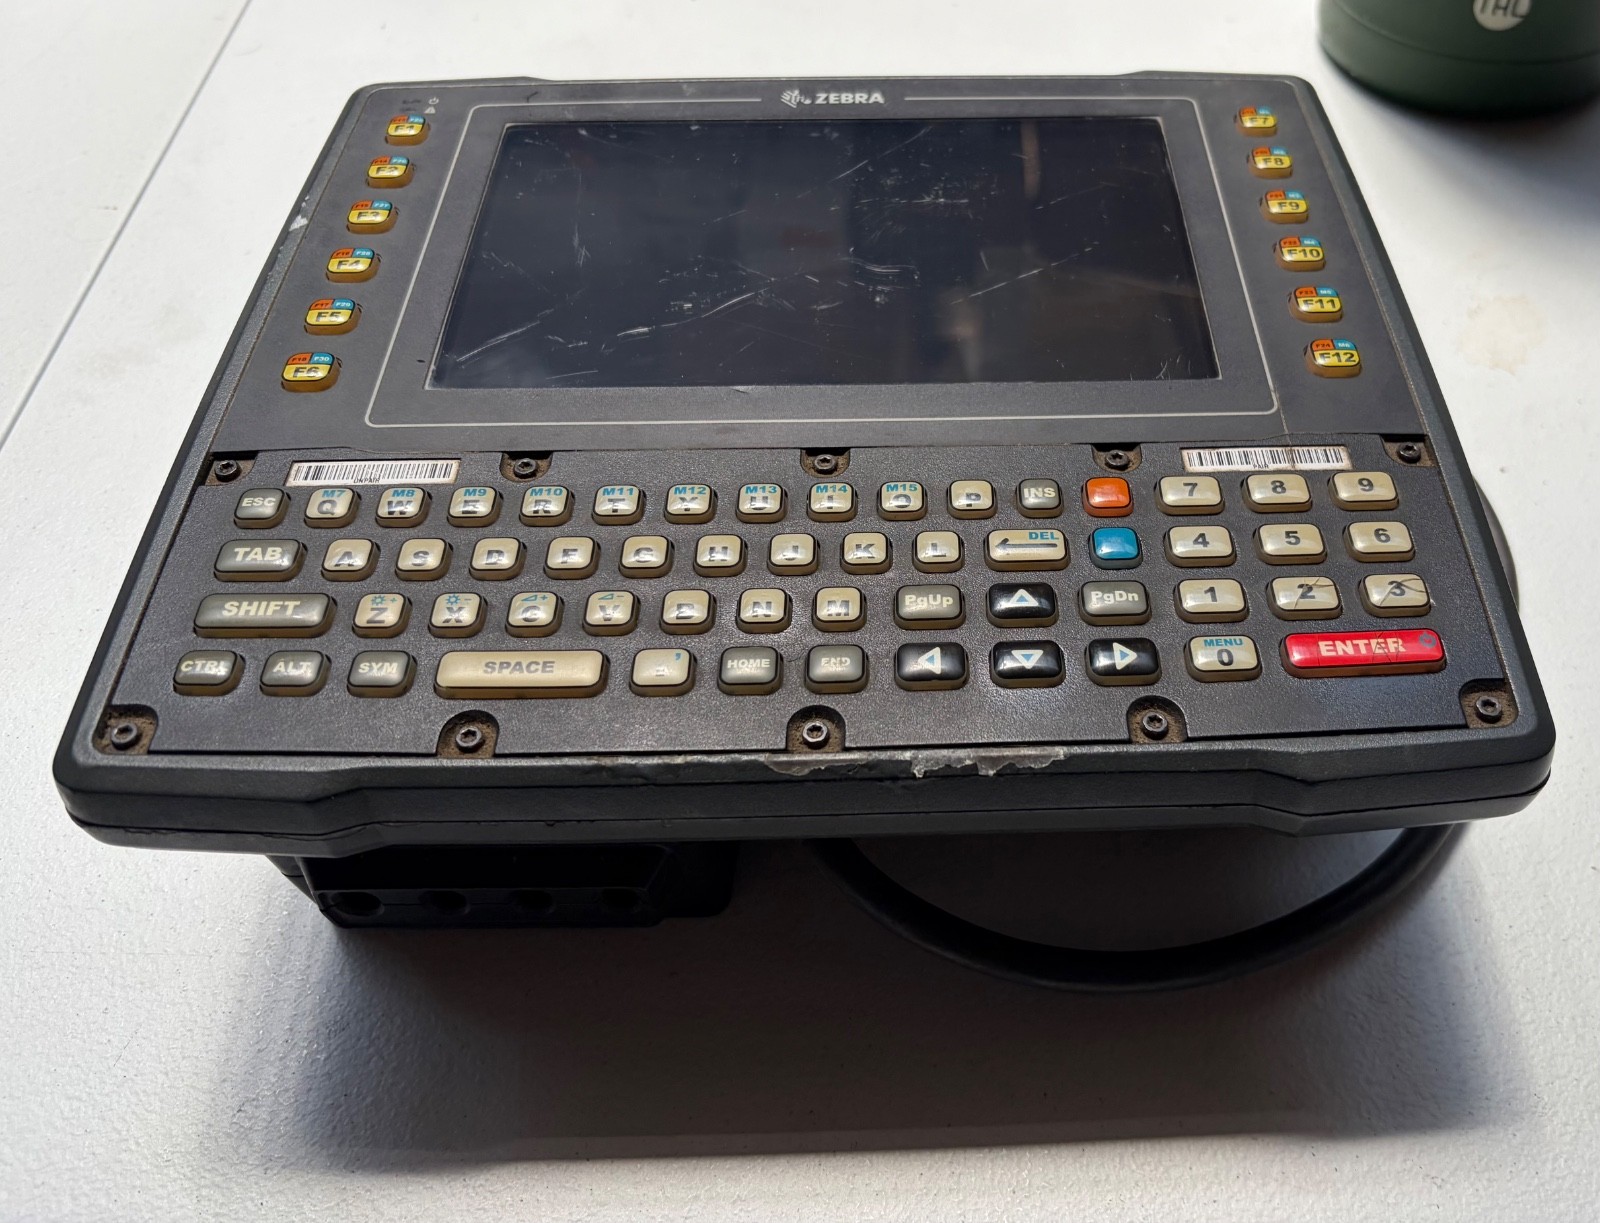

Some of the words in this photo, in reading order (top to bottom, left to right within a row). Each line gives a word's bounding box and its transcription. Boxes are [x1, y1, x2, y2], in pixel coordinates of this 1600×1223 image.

[815, 92, 885, 104] ZEBRA
[1262, 157, 1284, 166] F8
[375, 166, 398, 175] F2
[1277, 201, 1300, 211] F9
[357, 211, 380, 221] F3
[1286, 248, 1321, 259] F10
[336, 259, 361, 270] F4
[1302, 298, 1337, 309] F11
[315, 311, 342, 322] F5
[1318, 351, 1357, 363] F12
[292, 366, 320, 378] F6
[529, 487, 563, 496] M10
[602, 487, 634, 496] M11
[673, 486, 706, 495] M12
[745, 485, 777, 494] M13
[815, 484, 848, 493] M14
[885, 483, 918, 492] M15
[1182, 482, 1198, 497] 7
[1270, 480, 1287, 494] 8
[1357, 477, 1374, 492] 9
[321, 489, 346, 498] M7
[391, 489, 416, 498] M8
[463, 488, 487, 497] M9
[964, 492, 982, 508] P
[1023, 487, 1056, 499] INS
[241, 497, 276, 507] ESC
[317, 500, 338, 516] Q
[386, 500, 414, 516] W
[461, 499, 482, 515] E
[533, 498, 552, 514] R
[607, 497, 626, 513] T
[678, 496, 699, 512] Y
[893, 493, 912, 509] O
[1028, 531, 1060, 540] DEL
[1192, 532, 1210, 548] 4
[1284, 530, 1301, 546] 5
[1373, 527, 1391, 543] 6
[233, 547, 283, 562] TAB
[633, 547, 654, 563] G
[708, 546, 729, 562] H
[783, 545, 799, 561] J
[854, 543, 876, 559] K
[930, 542, 947, 558] L
[334, 550, 355, 567] A
[411, 550, 430, 567] S
[1203, 586, 1218, 603] 1
[1297, 583, 1316, 600] 2
[1387, 580, 1406, 597] 3
[904, 594, 954, 609] PgUp
[1091, 590, 1139, 605] PgDn
[222, 600, 301, 617] SHIFT
[366, 607, 389, 624] Z
[442, 606, 465, 624] X
[521, 605, 541, 623] C
[598, 604, 620, 622] V
[752, 601, 772, 617] N
[826, 600, 850, 616] M
[1203, 638, 1243, 647] MENU
[1319, 637, 1407, 657] ENTER
[727, 658, 771, 670] HOME
[820, 657, 851, 669] END
[1216, 648, 1234, 667] 0
[180, 660, 229, 674] CTRL
[272, 661, 312, 674] ALT
[358, 661, 398, 674] SYM
[483, 660, 555, 674] SPACE
